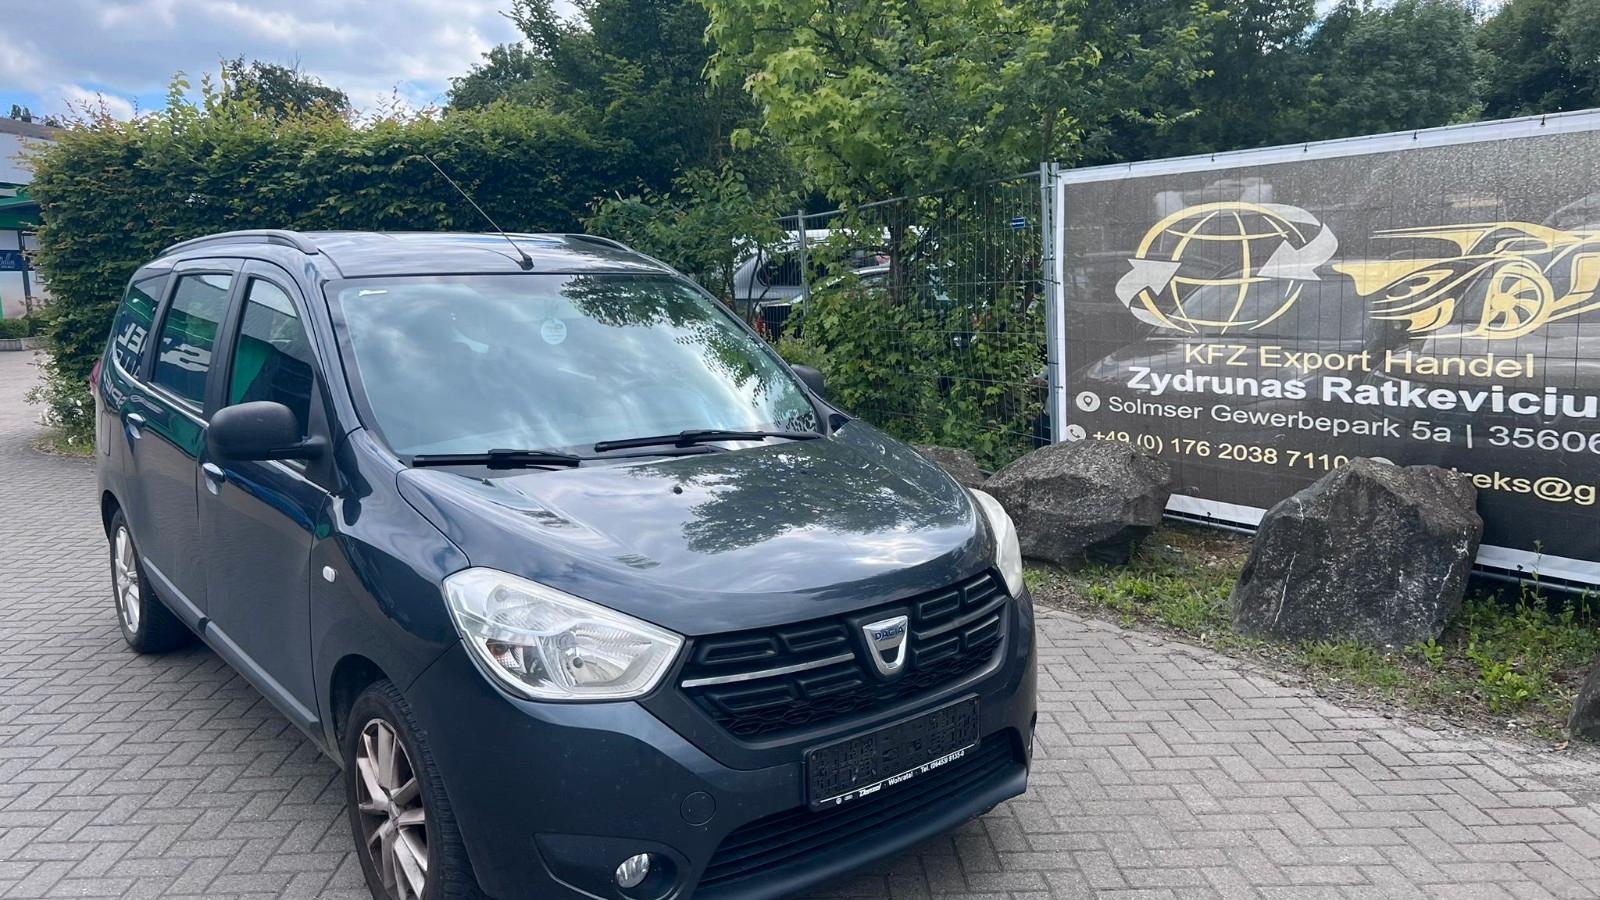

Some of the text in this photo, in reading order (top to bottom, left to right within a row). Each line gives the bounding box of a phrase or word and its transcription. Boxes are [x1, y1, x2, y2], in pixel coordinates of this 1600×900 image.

[1185, 343, 1534, 378] KFZ Export Handel
[1127, 366, 1598, 418] Zydrunas Ratkeviciu
[1109, 396, 1203, 419] Solmser
[1211, 404, 1400, 438] Gewerbepark
[1412, 420, 1451, 443] 5a
[1137, 433, 1163, 455] (0)
[1171, 438, 1211, 457] 176
[1217, 443, 1278, 465] 2038
[874, 625, 904, 641] DACIA
